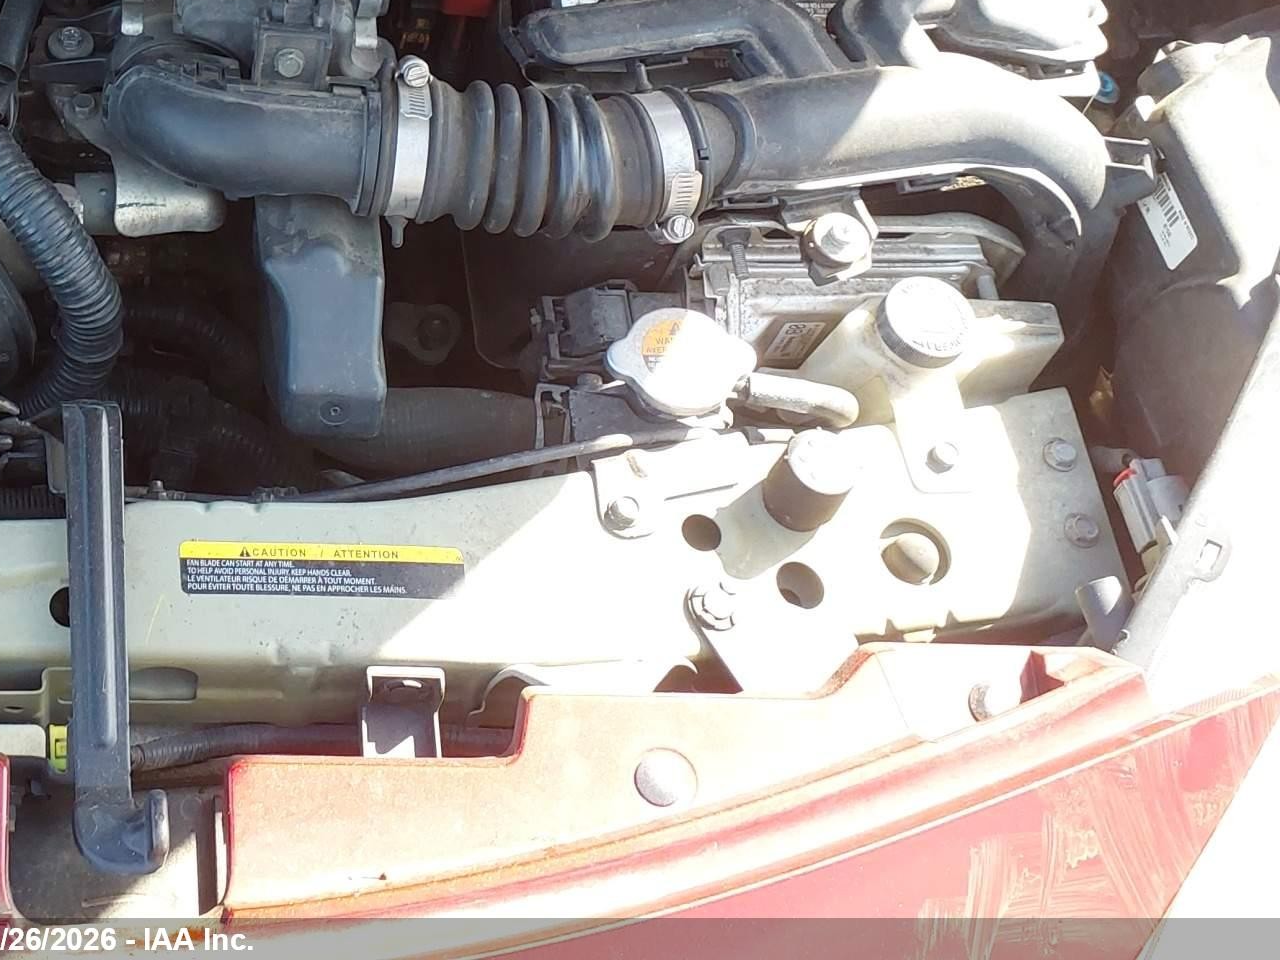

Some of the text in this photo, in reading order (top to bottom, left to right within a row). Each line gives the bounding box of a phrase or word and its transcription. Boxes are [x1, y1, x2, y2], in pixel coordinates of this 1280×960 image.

[252, 548, 307, 558] CAUTION
[333, 549, 399, 559] ATTENTION
[186, 559, 200, 567] FAN
[200, 559, 221, 567] BLADE
[221, 559, 235, 567] CAN
[187, 567, 196, 575] TO
[197, 567, 213, 575] HELP
[214, 567, 234, 575] AVOID
[235, 568, 267, 576] PERSONAL
[291, 568, 307, 576] KEEP
[307, 569, 330, 577] HANDS
[187, 575, 196, 583] LE
[196, 575, 242, 584] VENTILATEUR
[242, 576, 266, 584] RISQUE
[267, 576, 278, 584] DE
[278, 575, 317, 585] DÉMARRER
[323, 576, 343, 584] TOUT
[187, 582, 208, 591] POUR
[208, 581, 232, 591] ÉVITER
[232, 583, 254, 591] TOUTE
[292, 584, 302, 592] NE
[302, 584, 316, 592] PAS
[316, 584, 326, 592] EN
[327, 585, 369, 593] APPROCHER
[370, 586, 382, 594] LES
